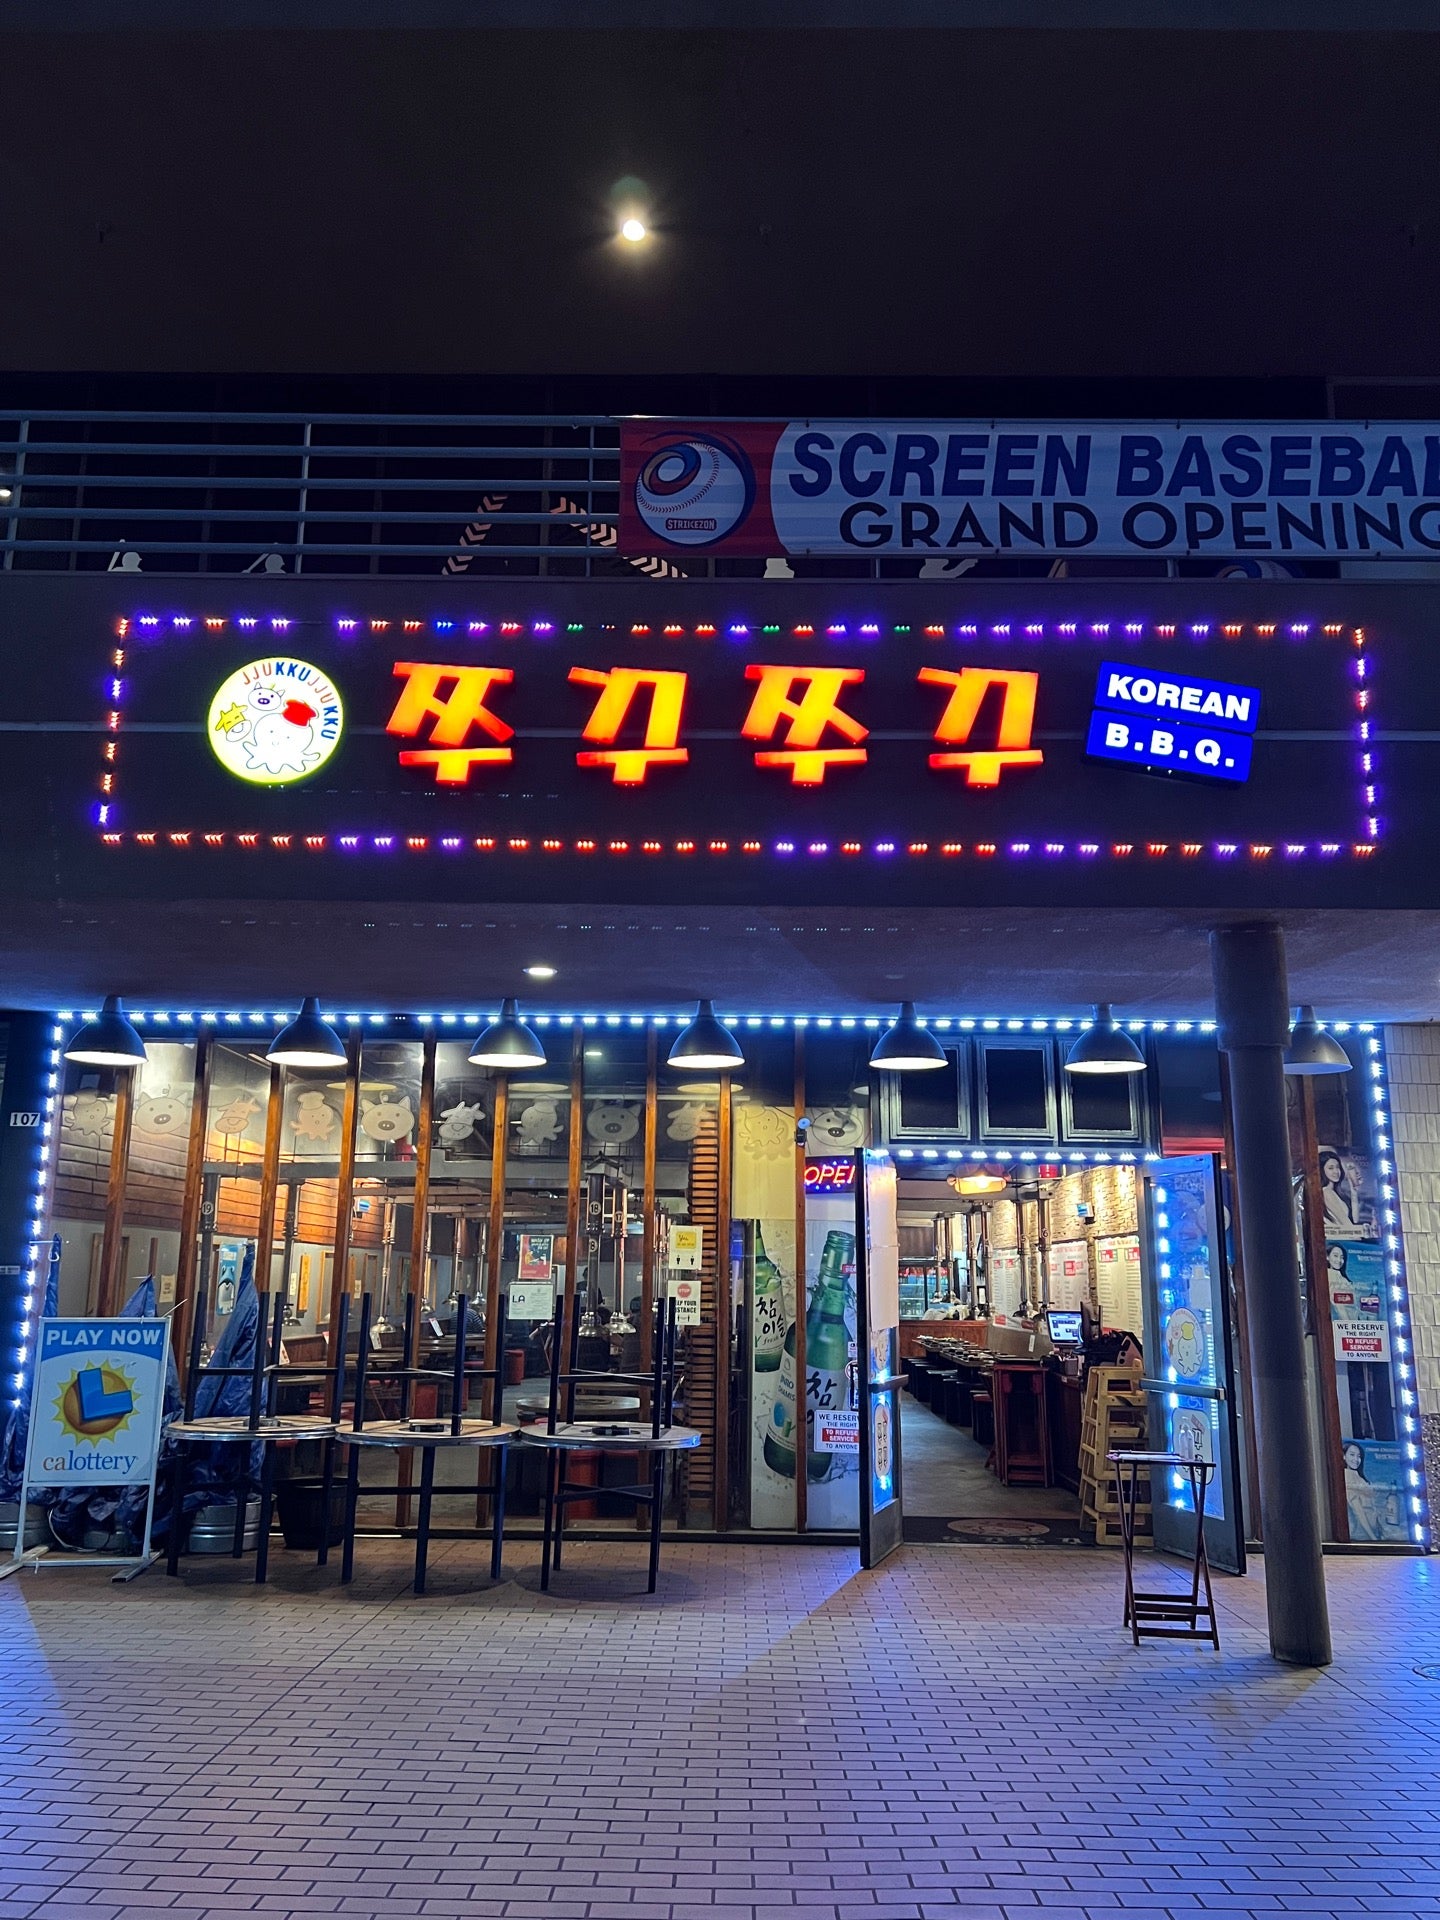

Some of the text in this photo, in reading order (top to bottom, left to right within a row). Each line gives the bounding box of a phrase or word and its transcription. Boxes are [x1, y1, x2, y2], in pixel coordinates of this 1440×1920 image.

[788, 432, 1092, 498] SCREEN
[667, 519, 715, 530] STRIKEZON
[839, 501, 1440, 550] GRAND OPENING
[1107, 673, 1250, 722] KOREAN
[1105, 721, 1235, 768] B.B.Q.
[12, 1113, 39, 1126] 107
[202, 1203, 212, 1212] 19
[590, 1205, 599, 1214] 18
[1337, 1323, 1385, 1331] WE RESERVE
[46, 1329, 103, 1346] PLAY
[819, 1413, 831, 1421] WE
[833, 1414, 857, 1422] RESER
[42, 1450, 137, 1475] calottery
